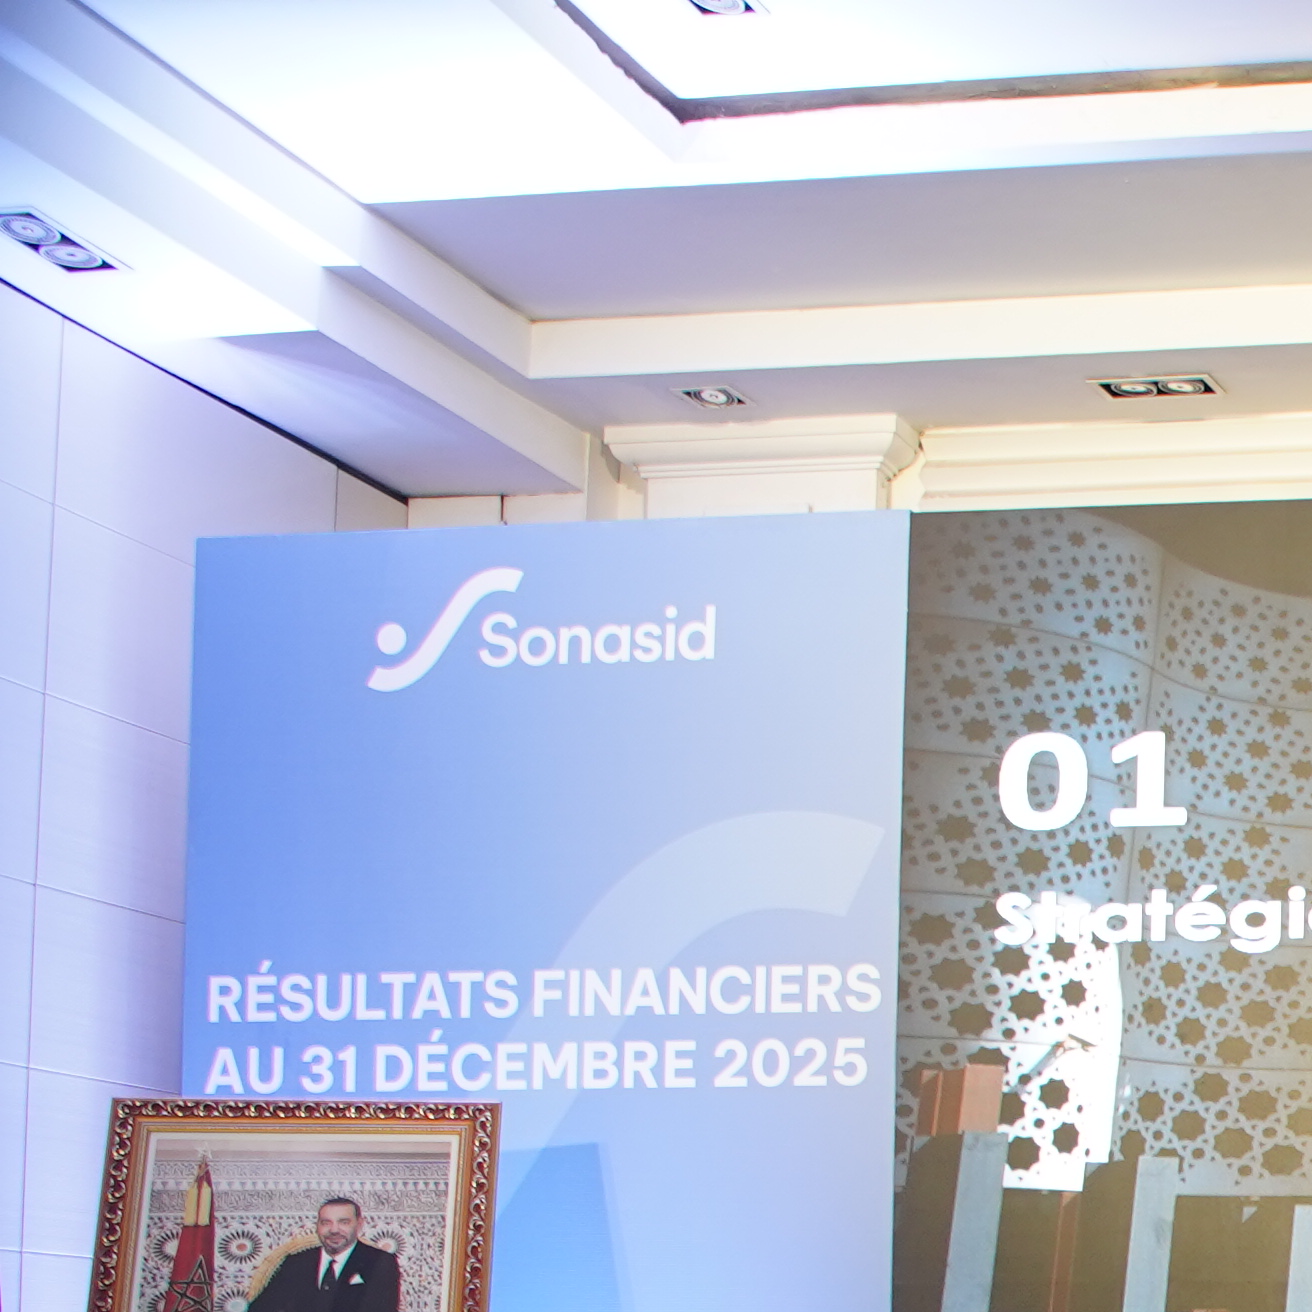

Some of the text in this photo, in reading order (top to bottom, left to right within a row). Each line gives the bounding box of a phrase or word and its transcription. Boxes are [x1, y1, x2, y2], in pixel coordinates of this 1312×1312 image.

[479, 605, 716, 668] Sonasid
[998, 731, 1188, 831] 01
[208, 961, 882, 1022] RÉSULTATS FINANCIERS
[205, 1030, 868, 1094] AU 31 DÉCEMBRE 2025
